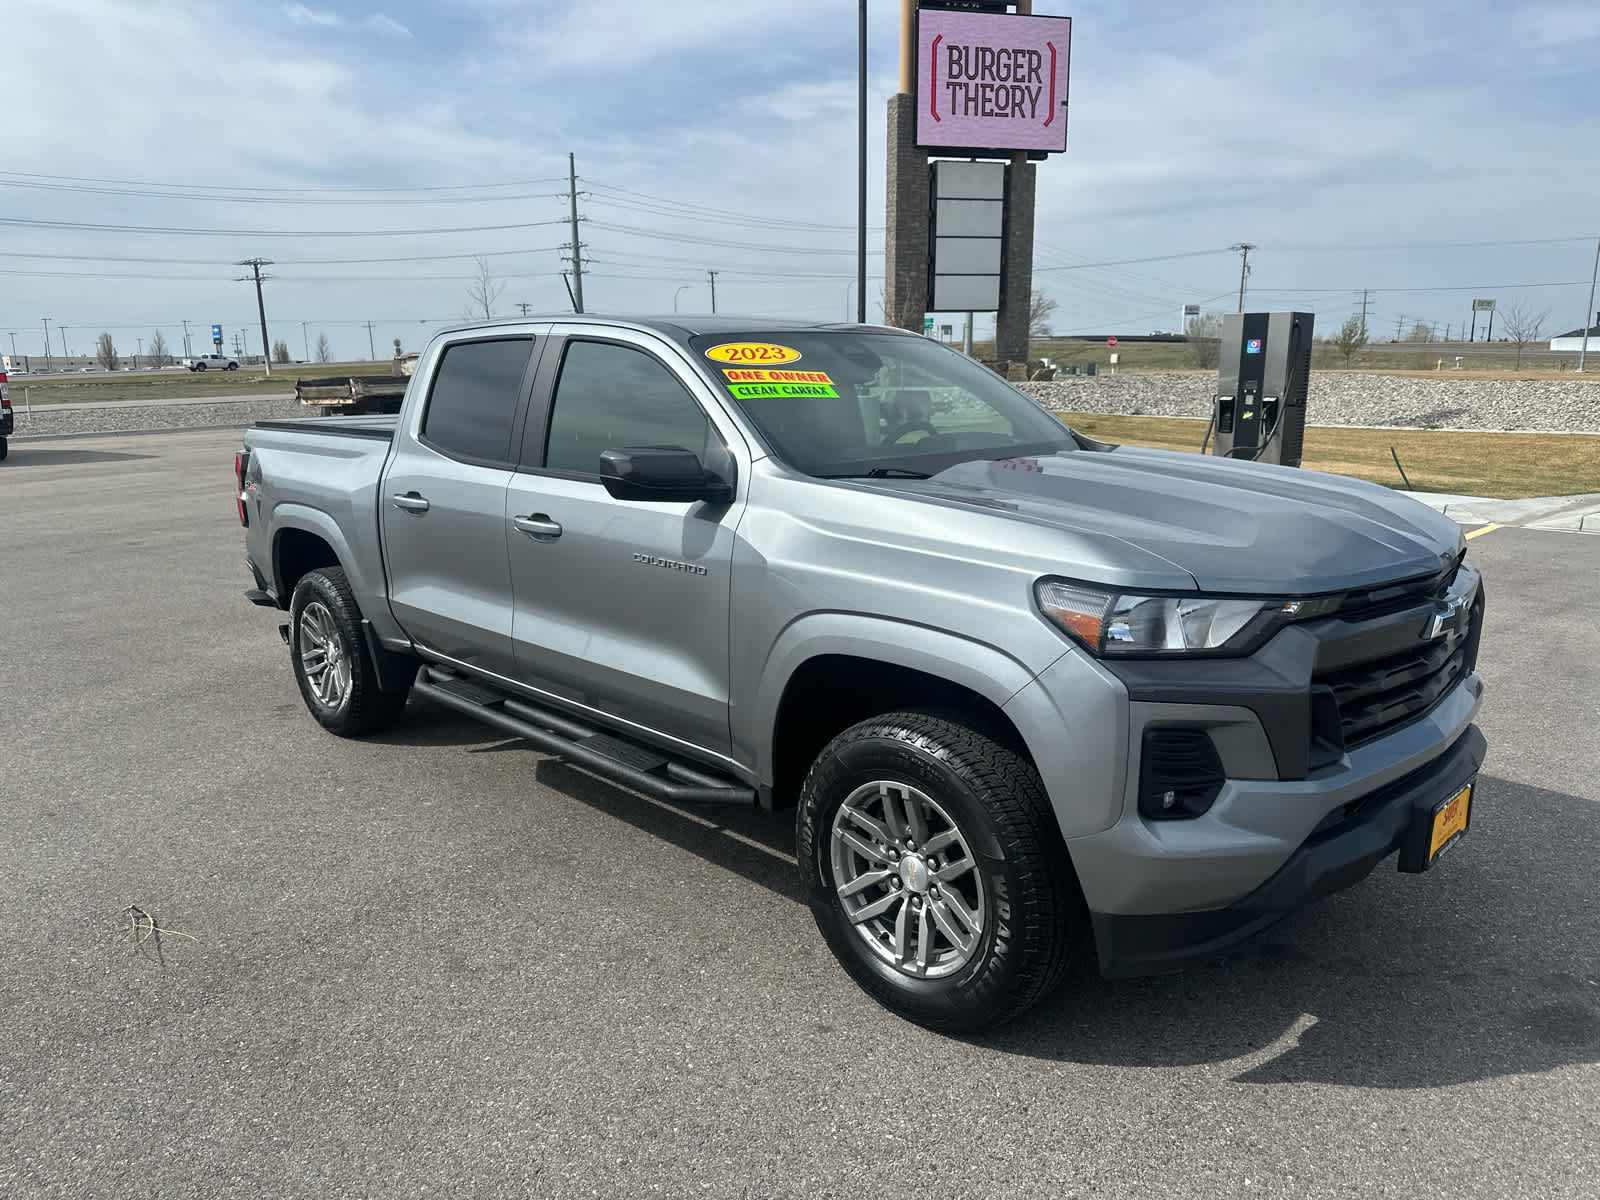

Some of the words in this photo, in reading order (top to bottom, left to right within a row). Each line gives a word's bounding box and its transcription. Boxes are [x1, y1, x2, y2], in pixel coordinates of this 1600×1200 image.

[946, 45, 1042, 83] BURGER
[946, 81, 1042, 119] THEORY
[725, 347, 786, 361] 2023
[727, 370, 767, 381] ONE
[769, 371, 830, 383] OWNER
[738, 386, 778, 396] CLEAN
[782, 386, 830, 395] CARFAX
[633, 553, 707, 576] COLORADO
